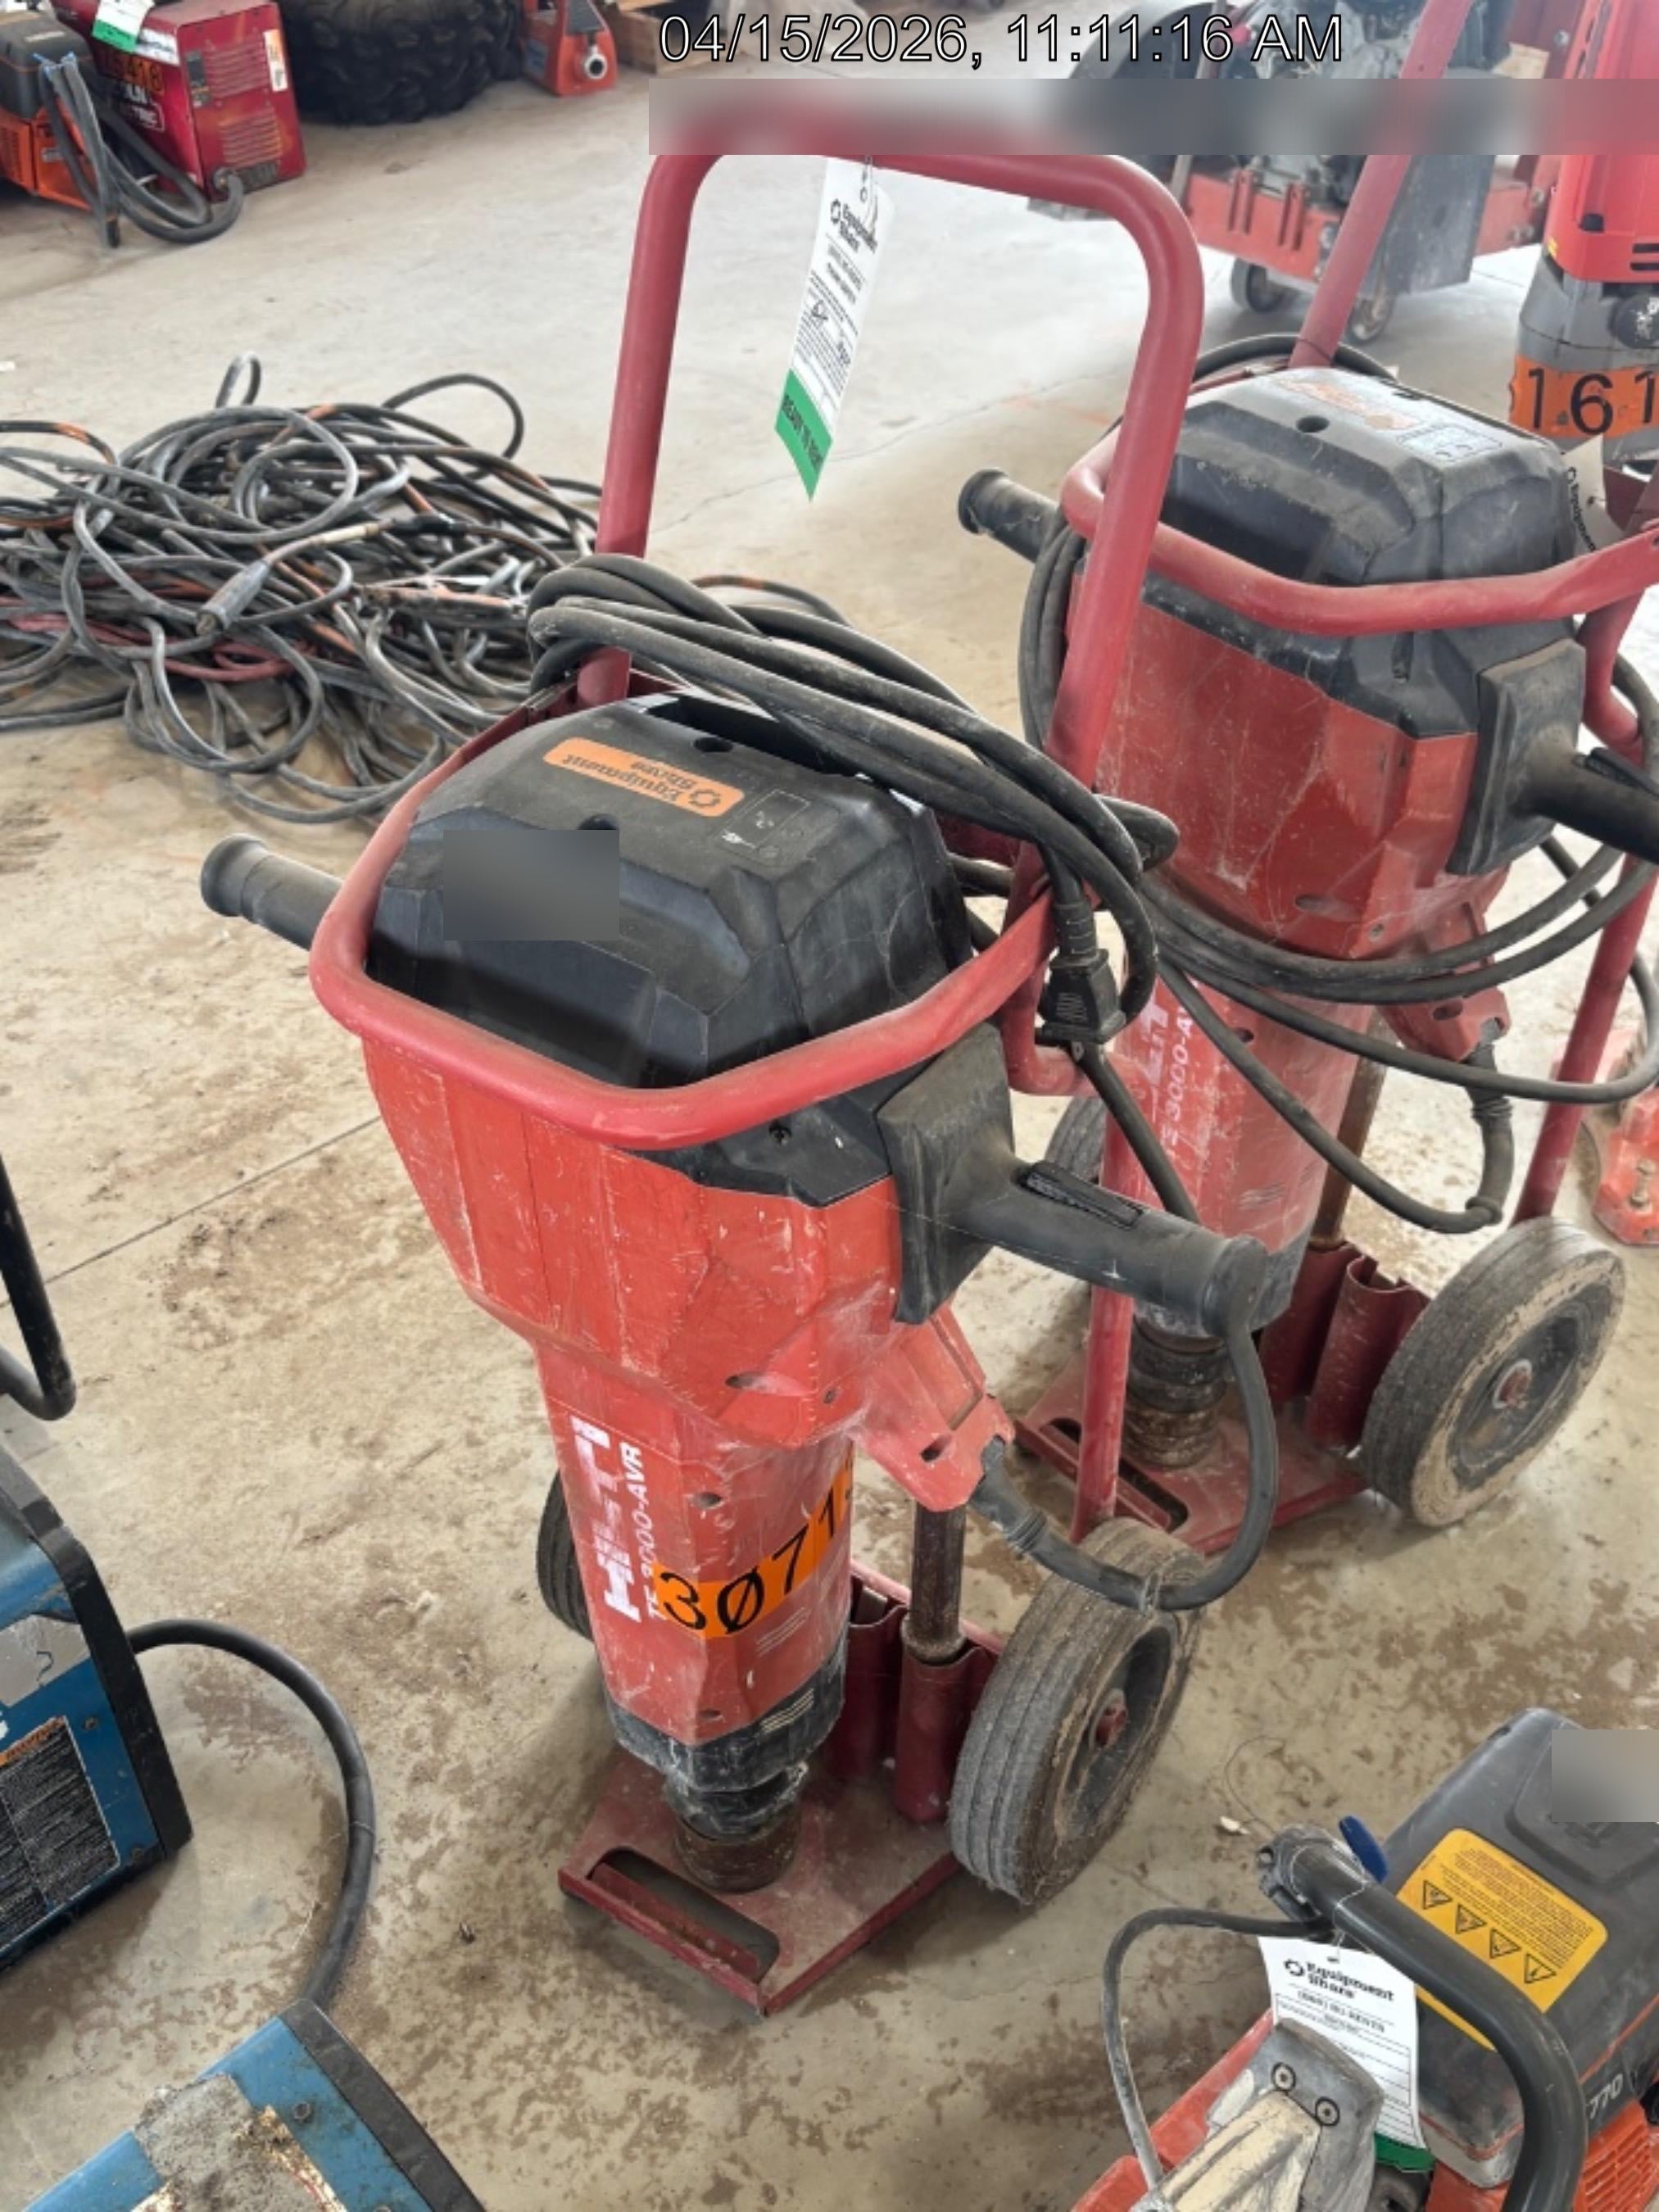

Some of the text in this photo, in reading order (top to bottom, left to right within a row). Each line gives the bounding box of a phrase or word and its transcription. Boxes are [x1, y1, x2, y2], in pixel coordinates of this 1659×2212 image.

[1508, 367, 1657, 436] 161
[1570, 483, 1597, 553] Equipmen
[659, 1454, 854, 1634] 3071
[1589, 2073, 1624, 2120] 770
